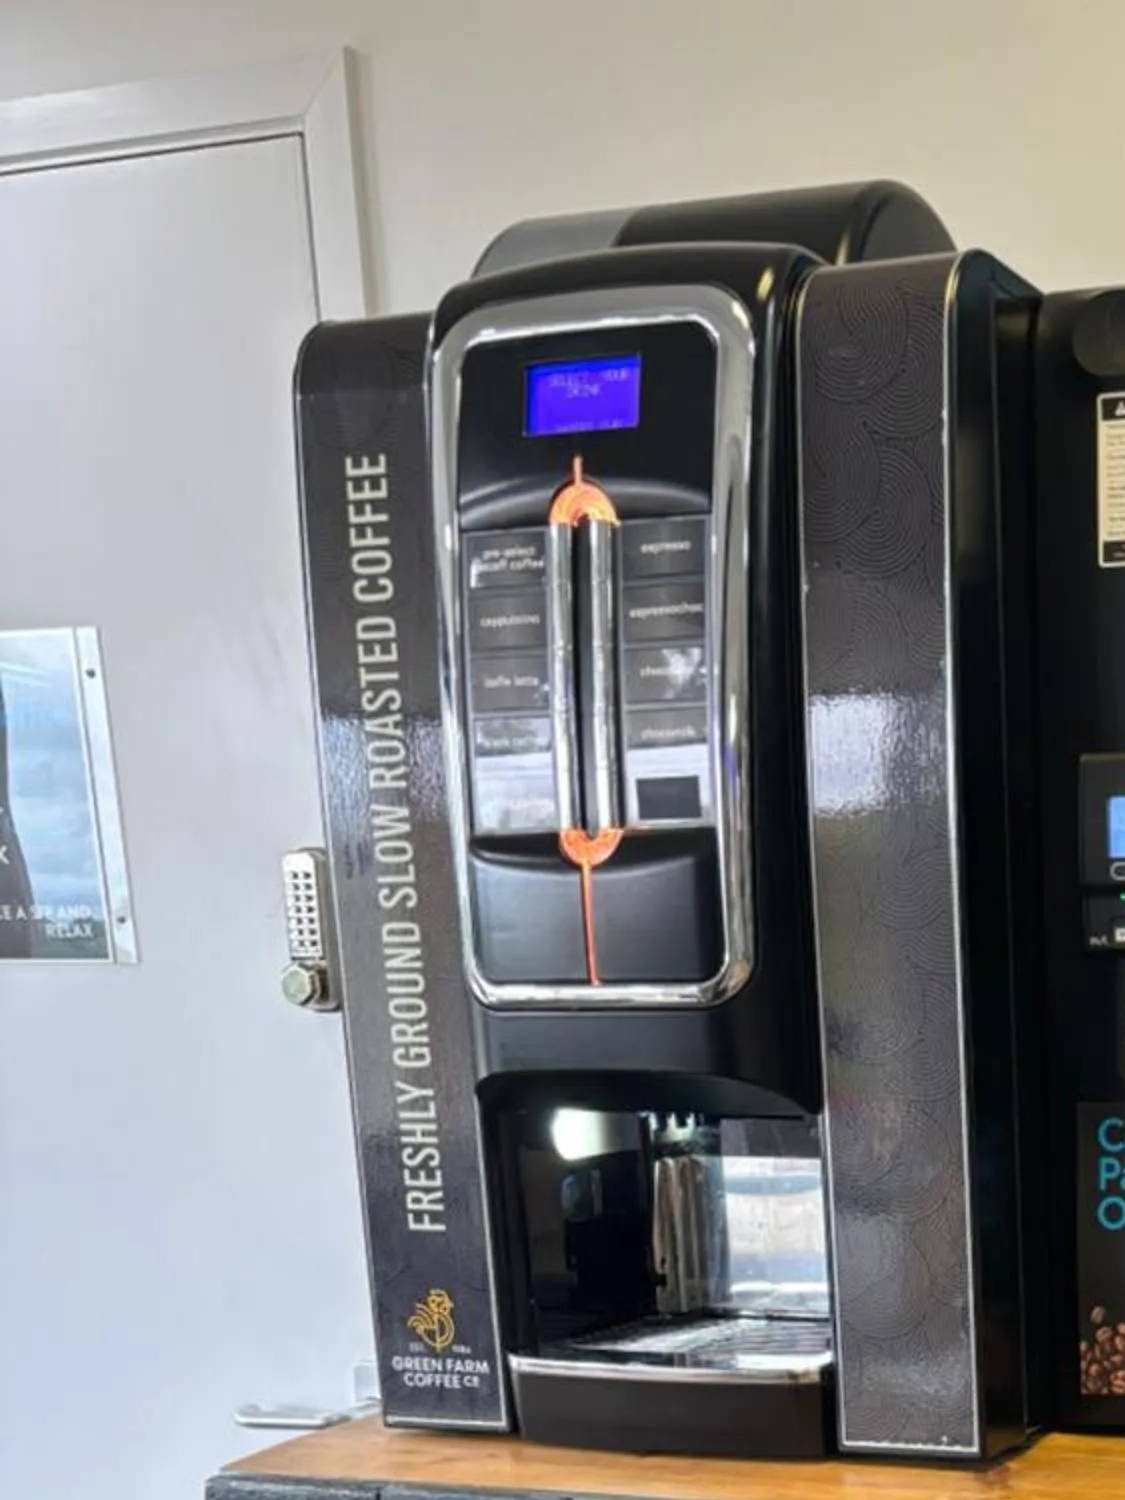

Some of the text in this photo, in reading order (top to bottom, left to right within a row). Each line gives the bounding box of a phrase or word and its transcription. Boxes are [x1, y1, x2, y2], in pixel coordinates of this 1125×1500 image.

[345, 453, 447, 1232] FRESHLY GROUND SLOW ROASTED COFFEE
[391, 1355, 490, 1375] GREEN FARM
[403, 1372, 461, 1389] COFFEE
